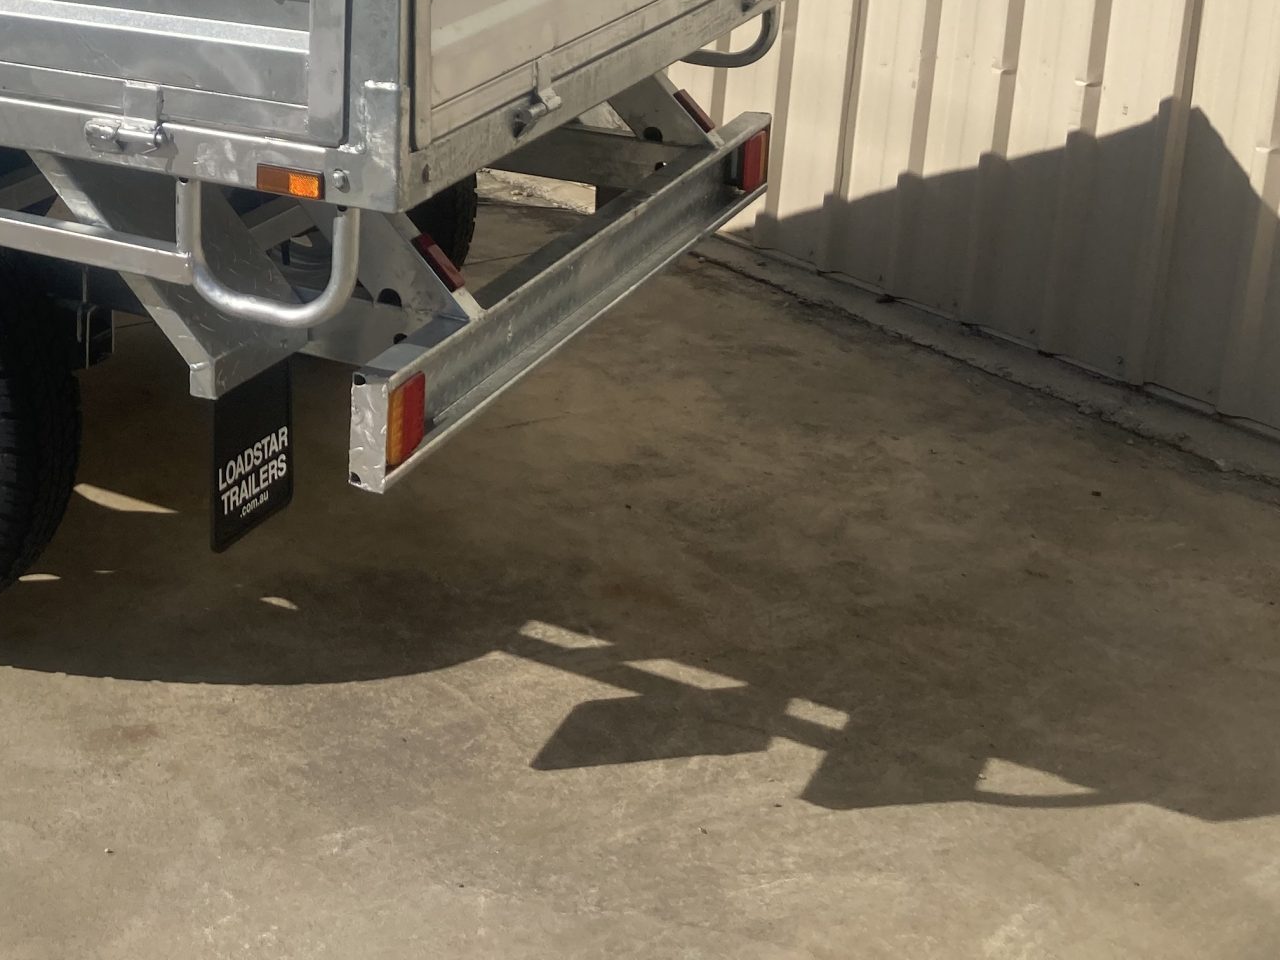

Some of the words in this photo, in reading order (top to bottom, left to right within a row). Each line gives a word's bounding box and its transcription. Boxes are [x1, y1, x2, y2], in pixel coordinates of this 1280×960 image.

[218, 425, 289, 492] LOADSTAR
[221, 453, 288, 515] TRAILERS
[239, 490, 269, 518] .com.au
